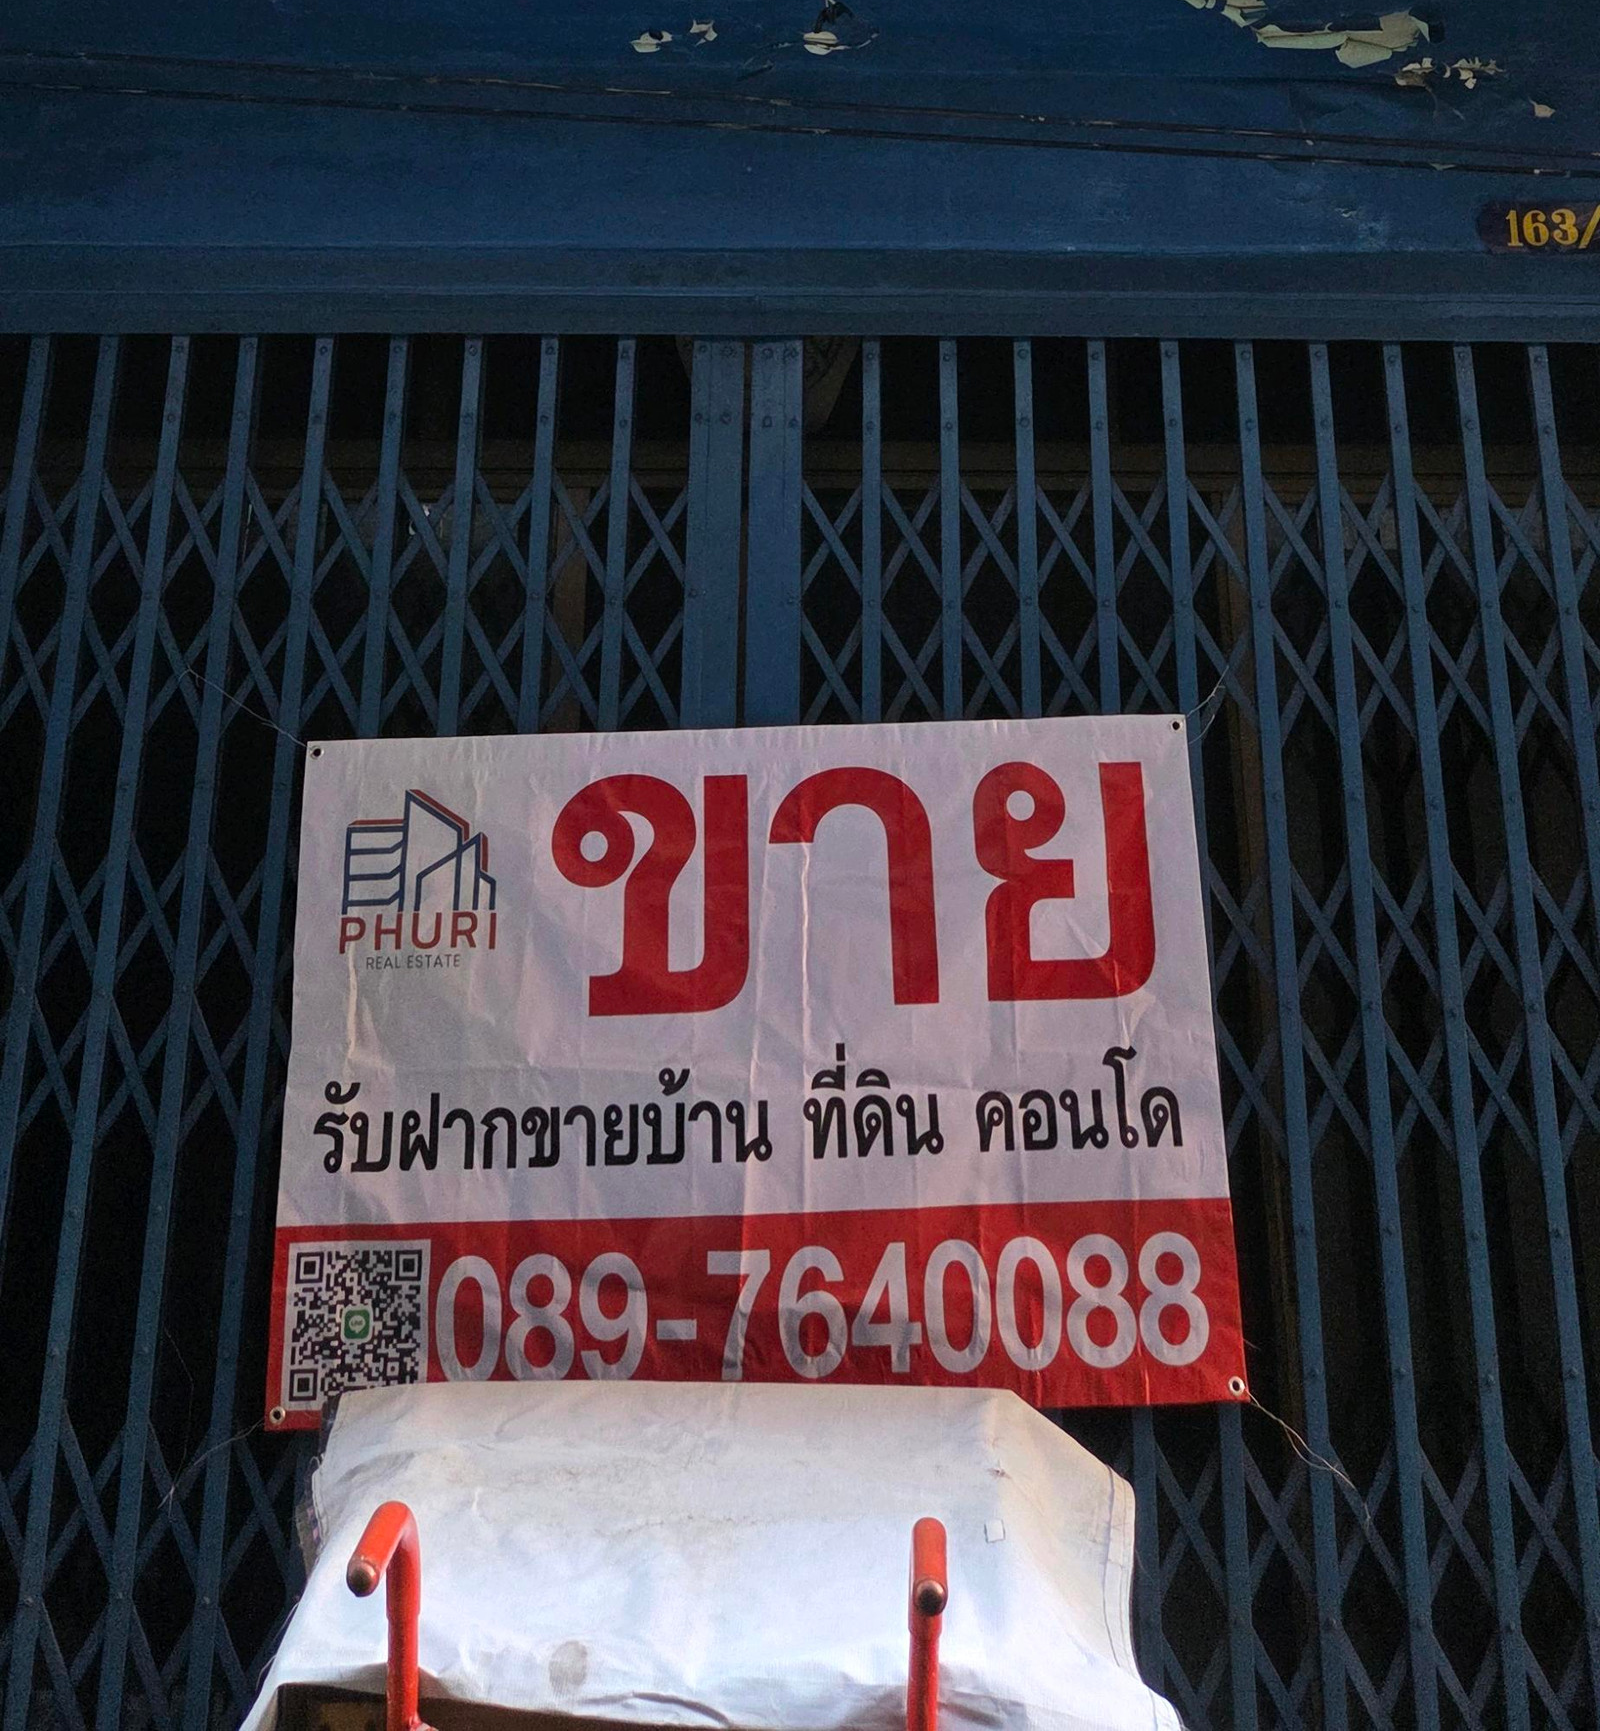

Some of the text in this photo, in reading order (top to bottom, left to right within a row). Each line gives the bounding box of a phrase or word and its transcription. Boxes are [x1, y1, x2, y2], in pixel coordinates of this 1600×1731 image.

[1505, 204, 1600, 249] 163/
[339, 911, 497, 954] PHURI
[552, 761, 1156, 1017] ขาย
[366, 953, 461, 970] REAL ESTATE
[314, 1043, 1183, 1174] รับฝากขายบ้าน ที่ดิน คอนโด
[436, 1231, 1210, 1381] 089-7640088
